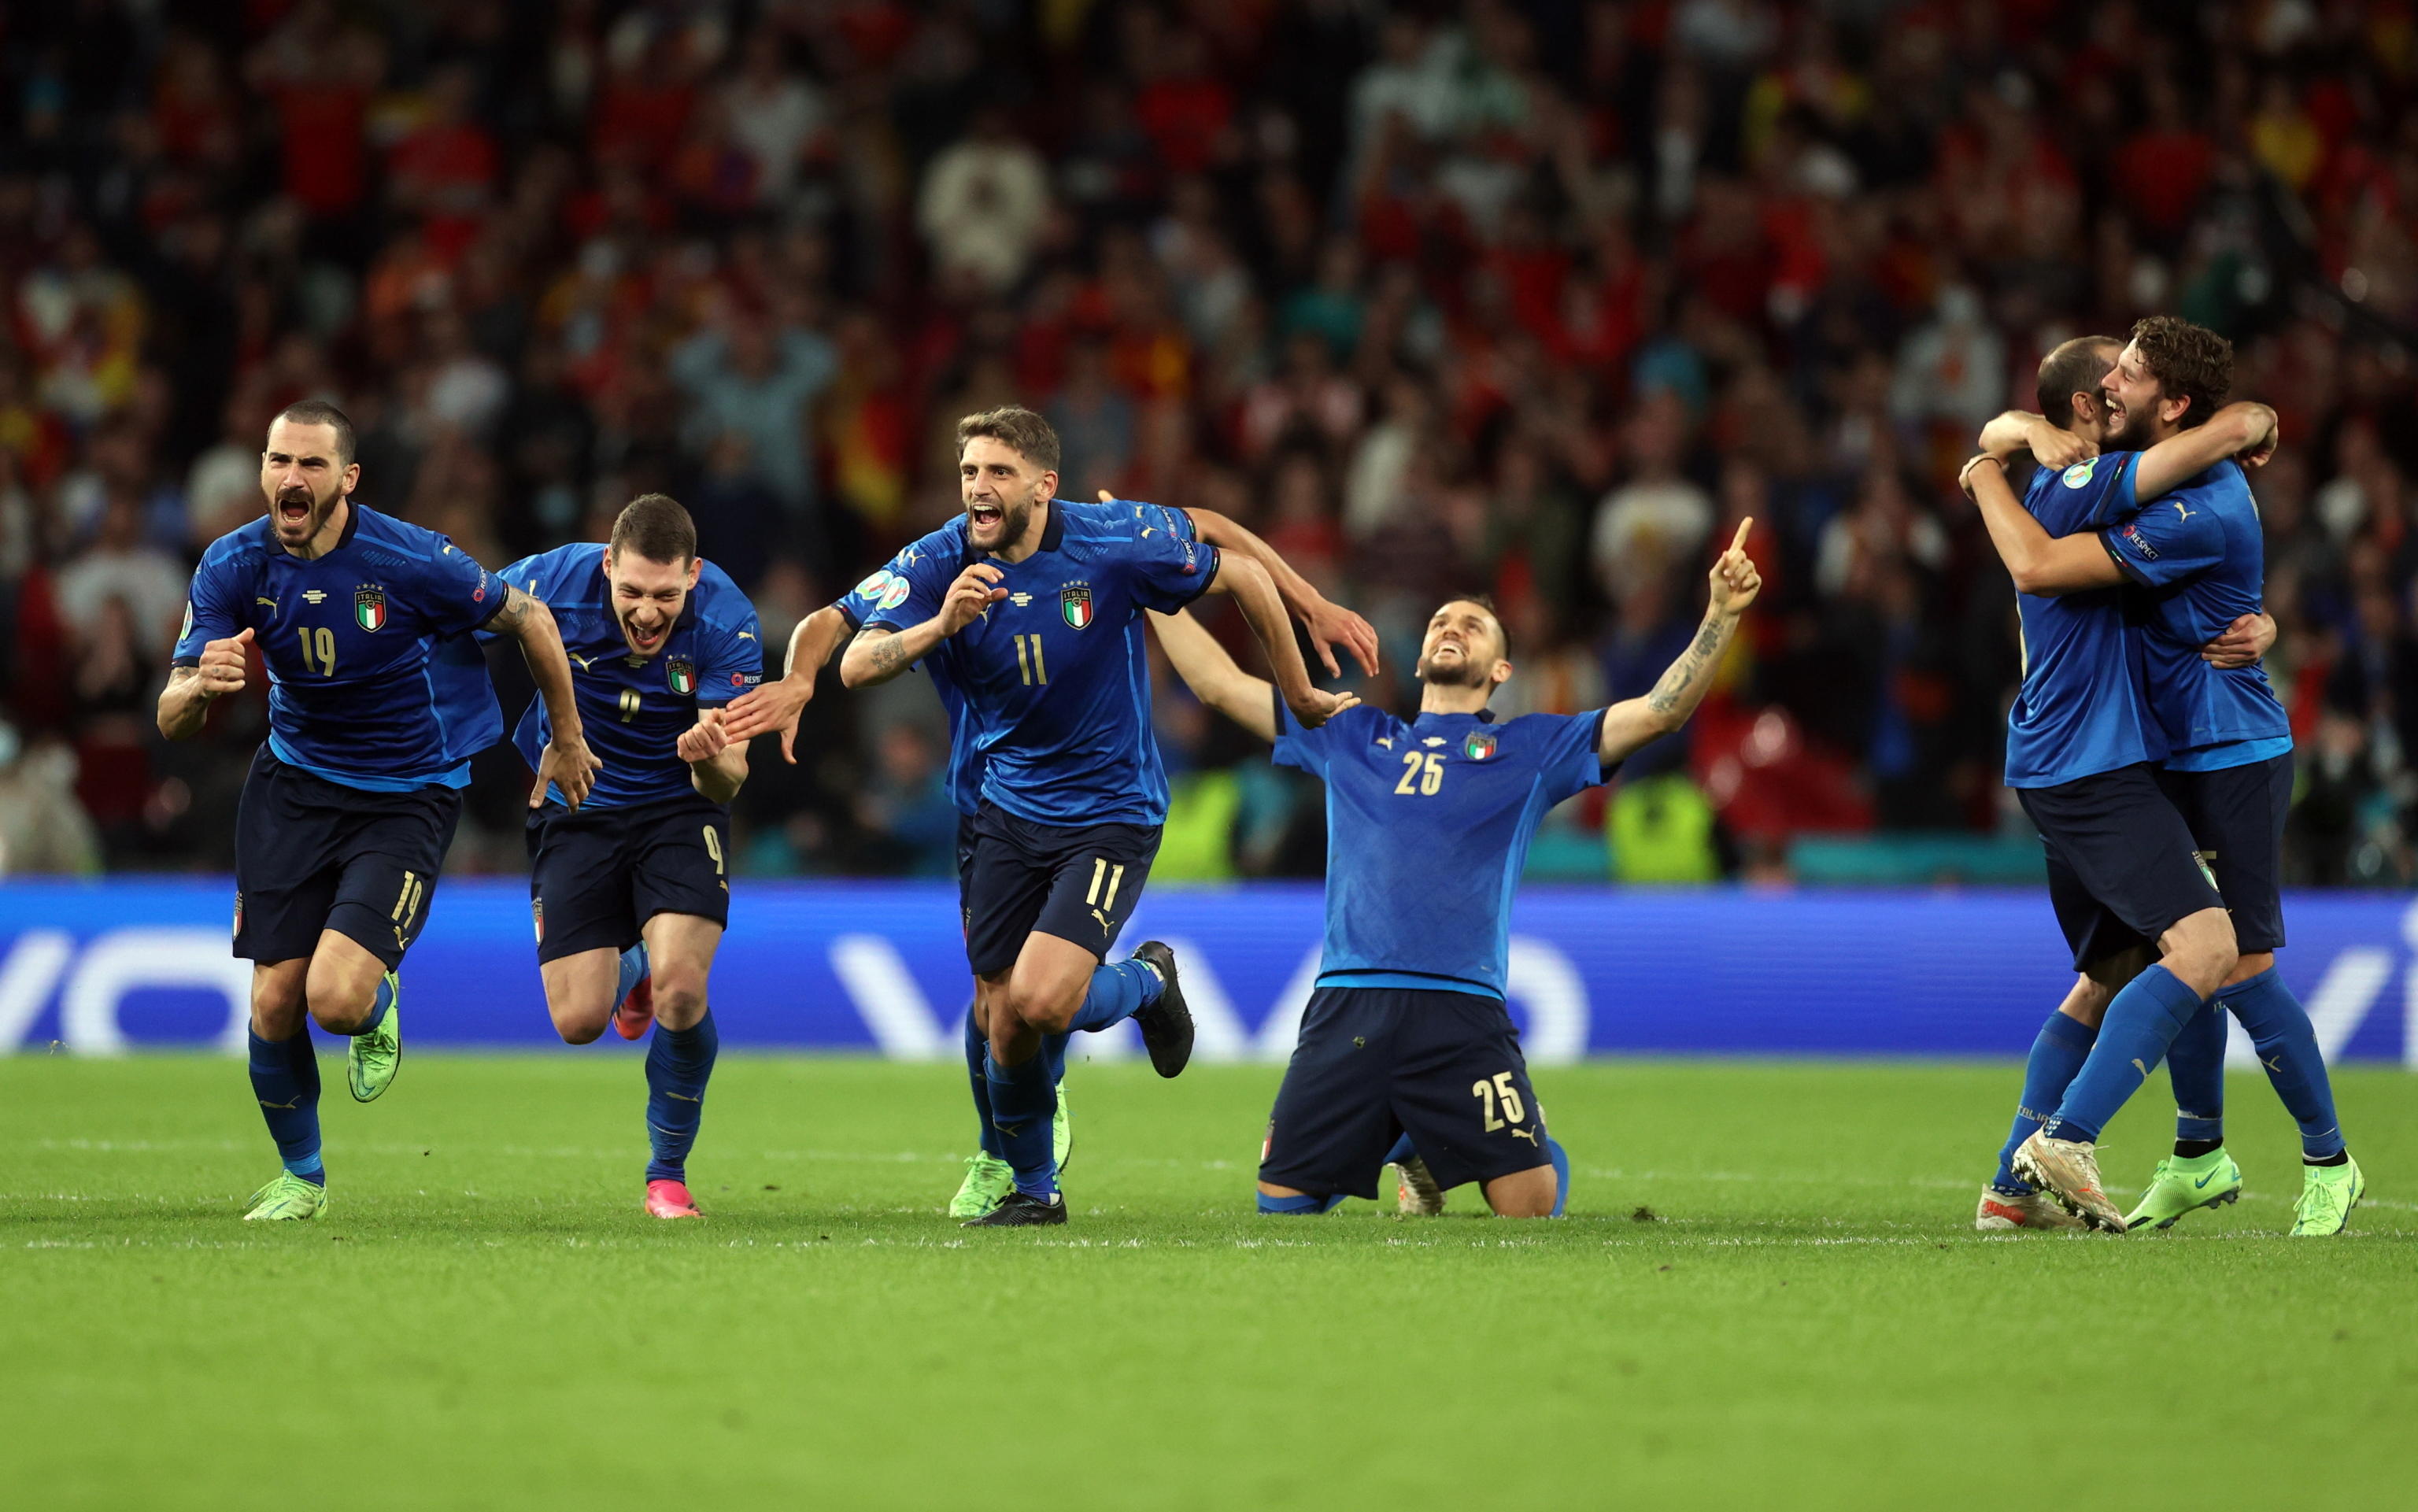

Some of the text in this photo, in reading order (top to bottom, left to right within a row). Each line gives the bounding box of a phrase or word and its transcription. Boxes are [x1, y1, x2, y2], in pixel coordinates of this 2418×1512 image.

[2130, 532, 2159, 560] RESPECT
[1063, 590, 1089, 599] ITALIA
[298, 627, 336, 677] 19
[1014, 634, 1047, 686] 11
[619, 688, 641, 723] 9
[1394, 750, 1447, 796] 25
[703, 825, 724, 875] 9
[391, 870, 423, 930] 19
[1085, 857, 1125, 912] 11
[1472, 1070, 1525, 1133] 25
